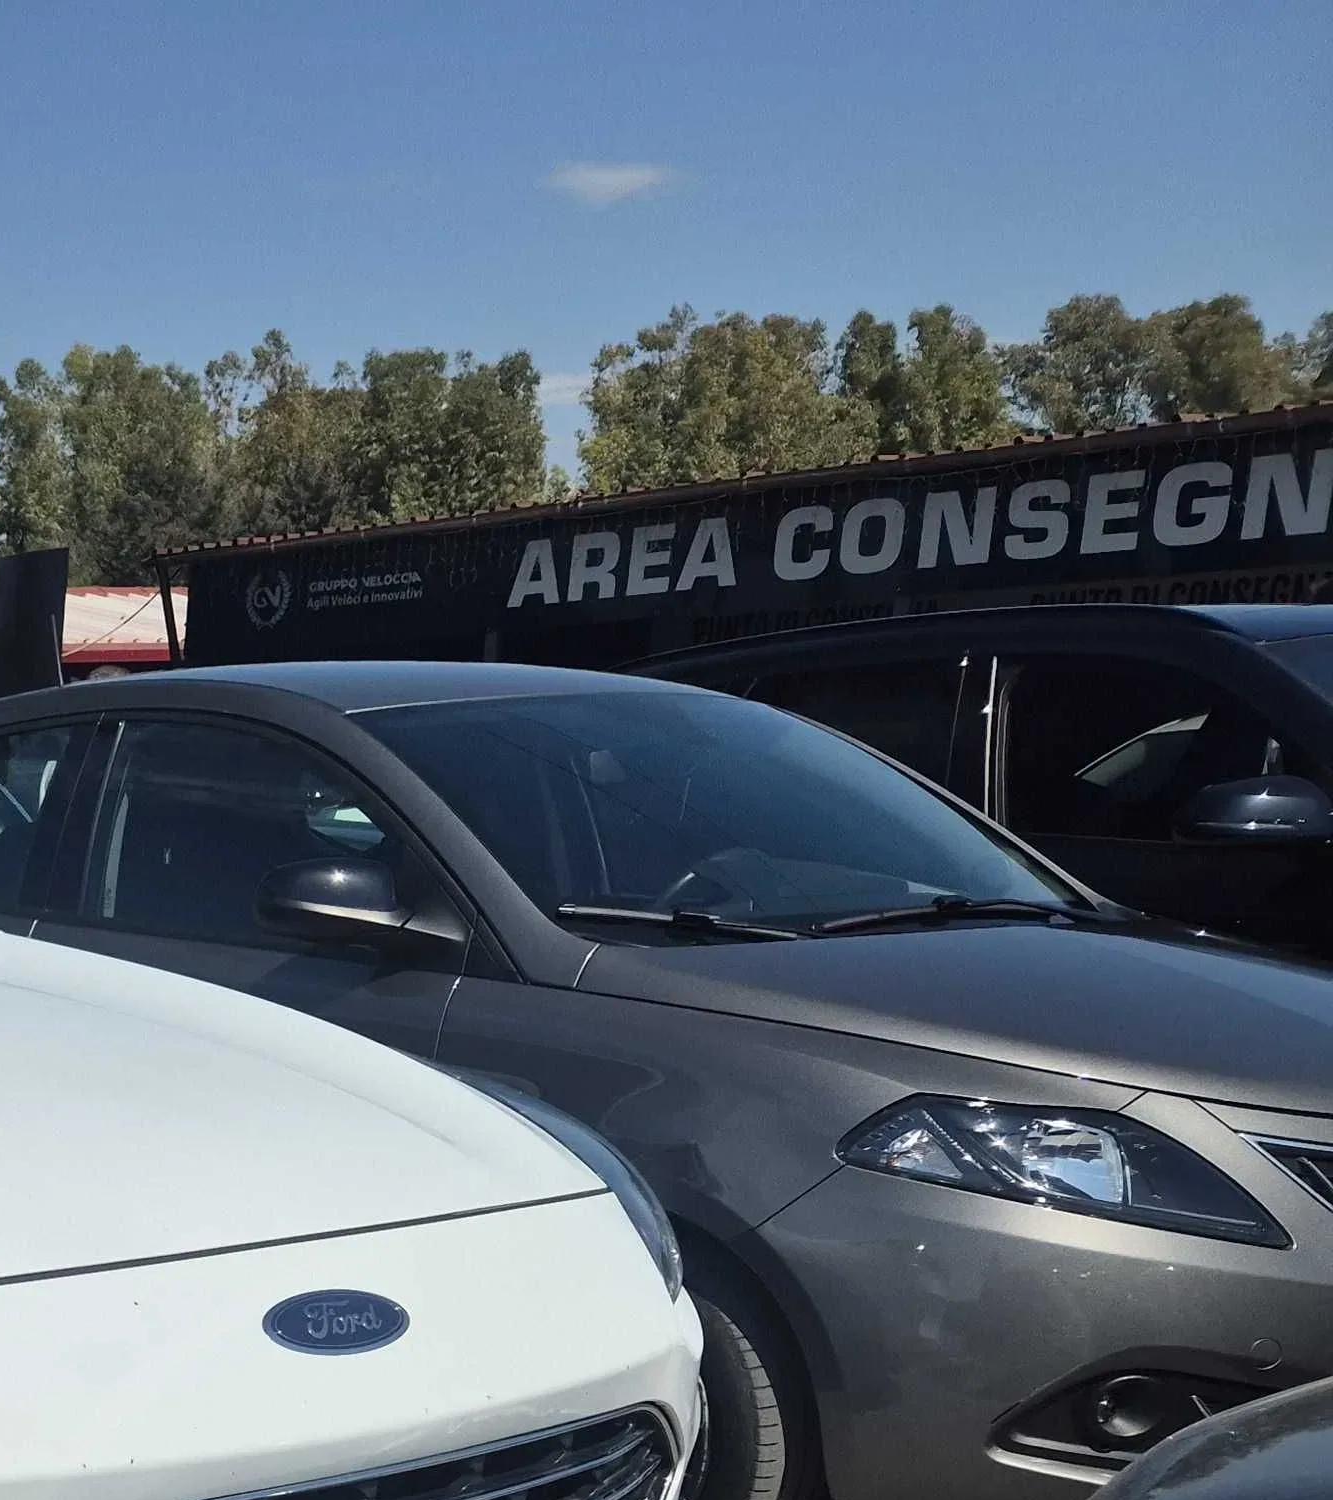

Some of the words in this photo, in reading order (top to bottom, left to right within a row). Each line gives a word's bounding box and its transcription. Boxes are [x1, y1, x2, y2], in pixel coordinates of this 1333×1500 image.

[309, 579, 358, 593] GRUPPO
[361, 571, 422, 588] VELOCCIA
[507, 517, 737, 608] AREA
[303, 1299, 383, 1340] Ford
